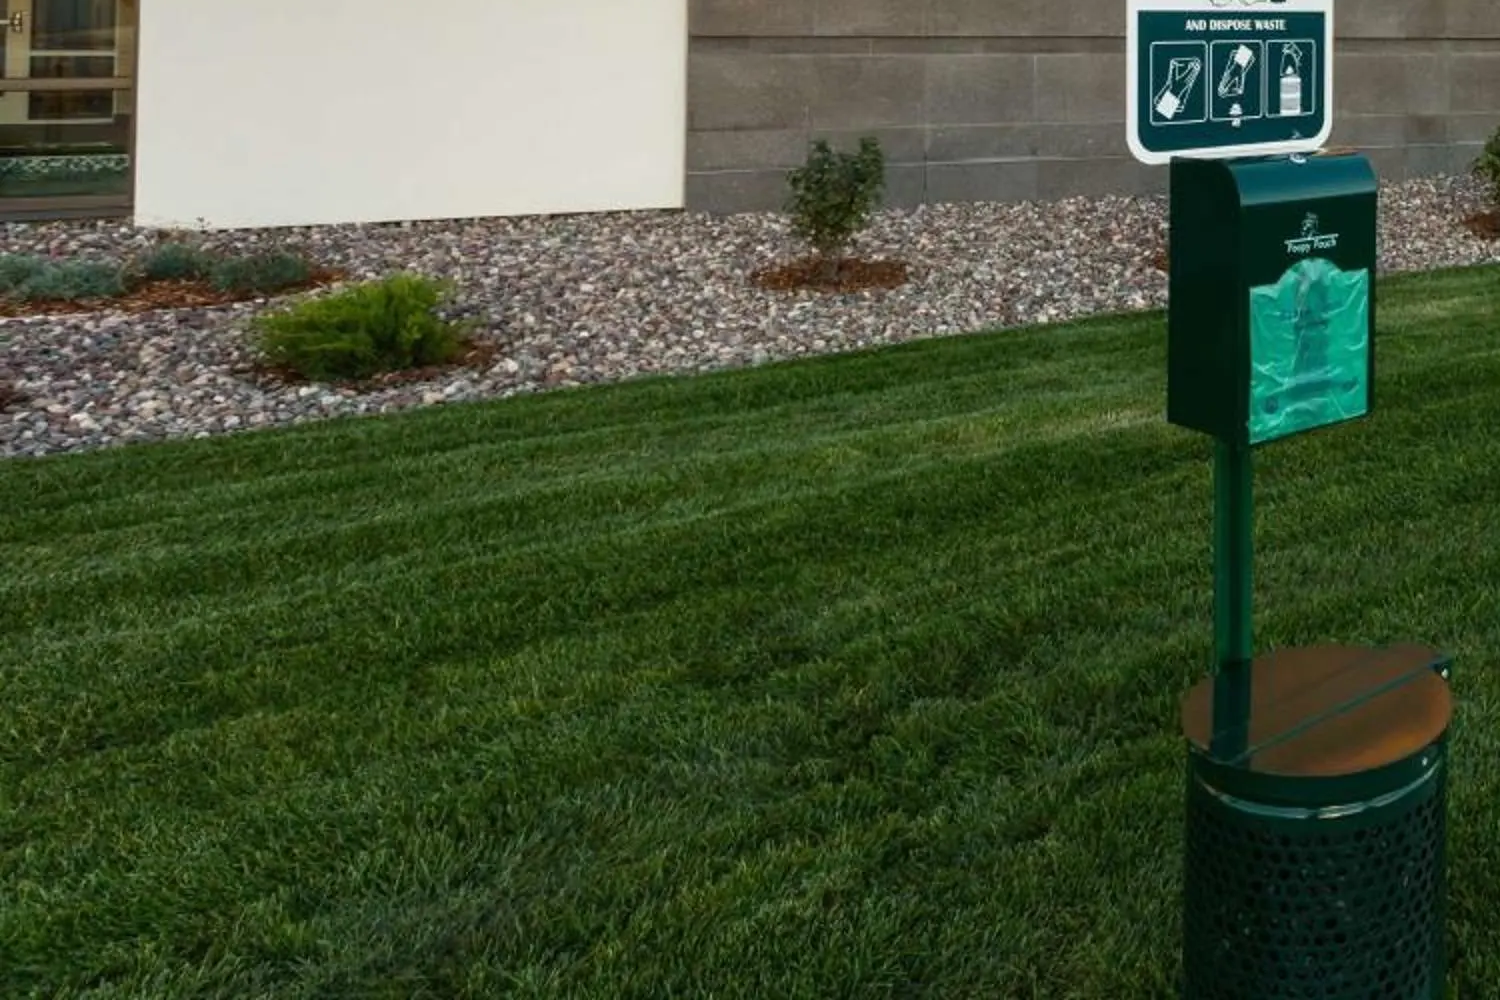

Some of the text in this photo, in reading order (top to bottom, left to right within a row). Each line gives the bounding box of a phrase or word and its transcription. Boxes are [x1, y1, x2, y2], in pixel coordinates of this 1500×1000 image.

[1184, 19, 1287, 31] AND DISPOSE WASTE
